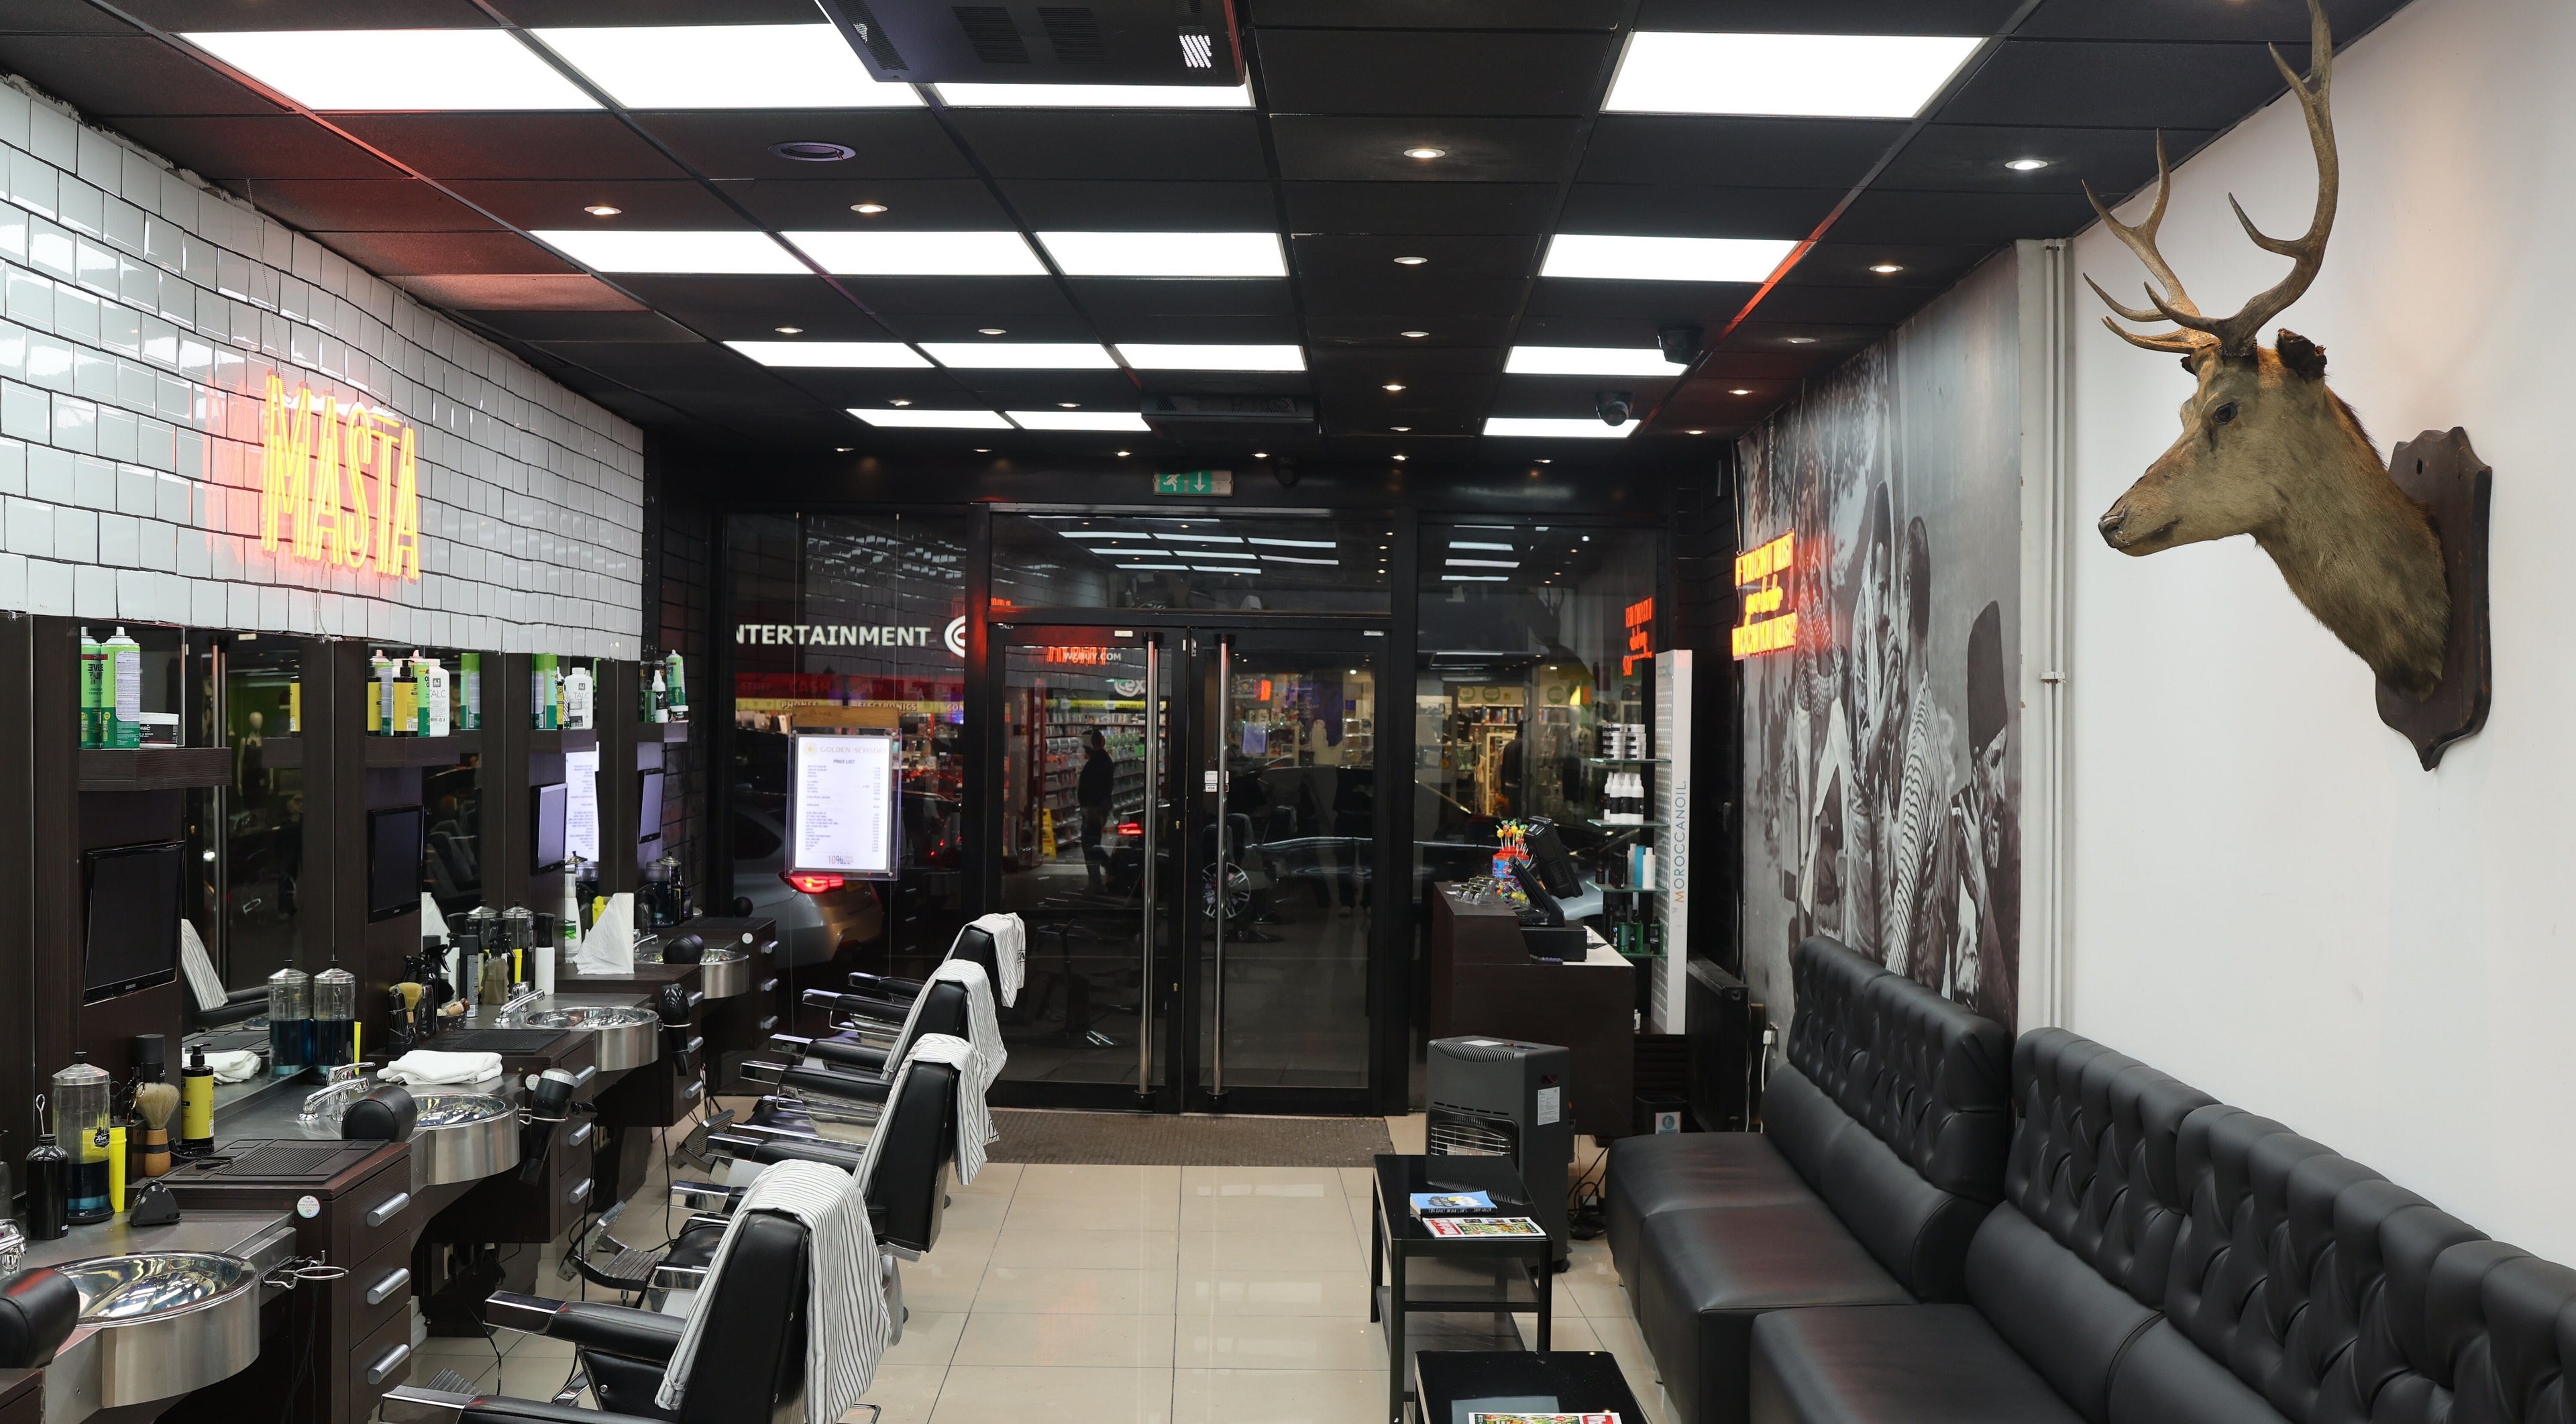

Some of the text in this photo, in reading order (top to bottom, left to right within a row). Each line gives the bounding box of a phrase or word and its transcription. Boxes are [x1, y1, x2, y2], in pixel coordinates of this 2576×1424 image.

[262, 373, 421, 581] MASTA
[854, 747, 888, 755] SCISSORS
[828, 855, 843, 865] 10%
[1674, 783, 1686, 903] MOROCCANOIL
